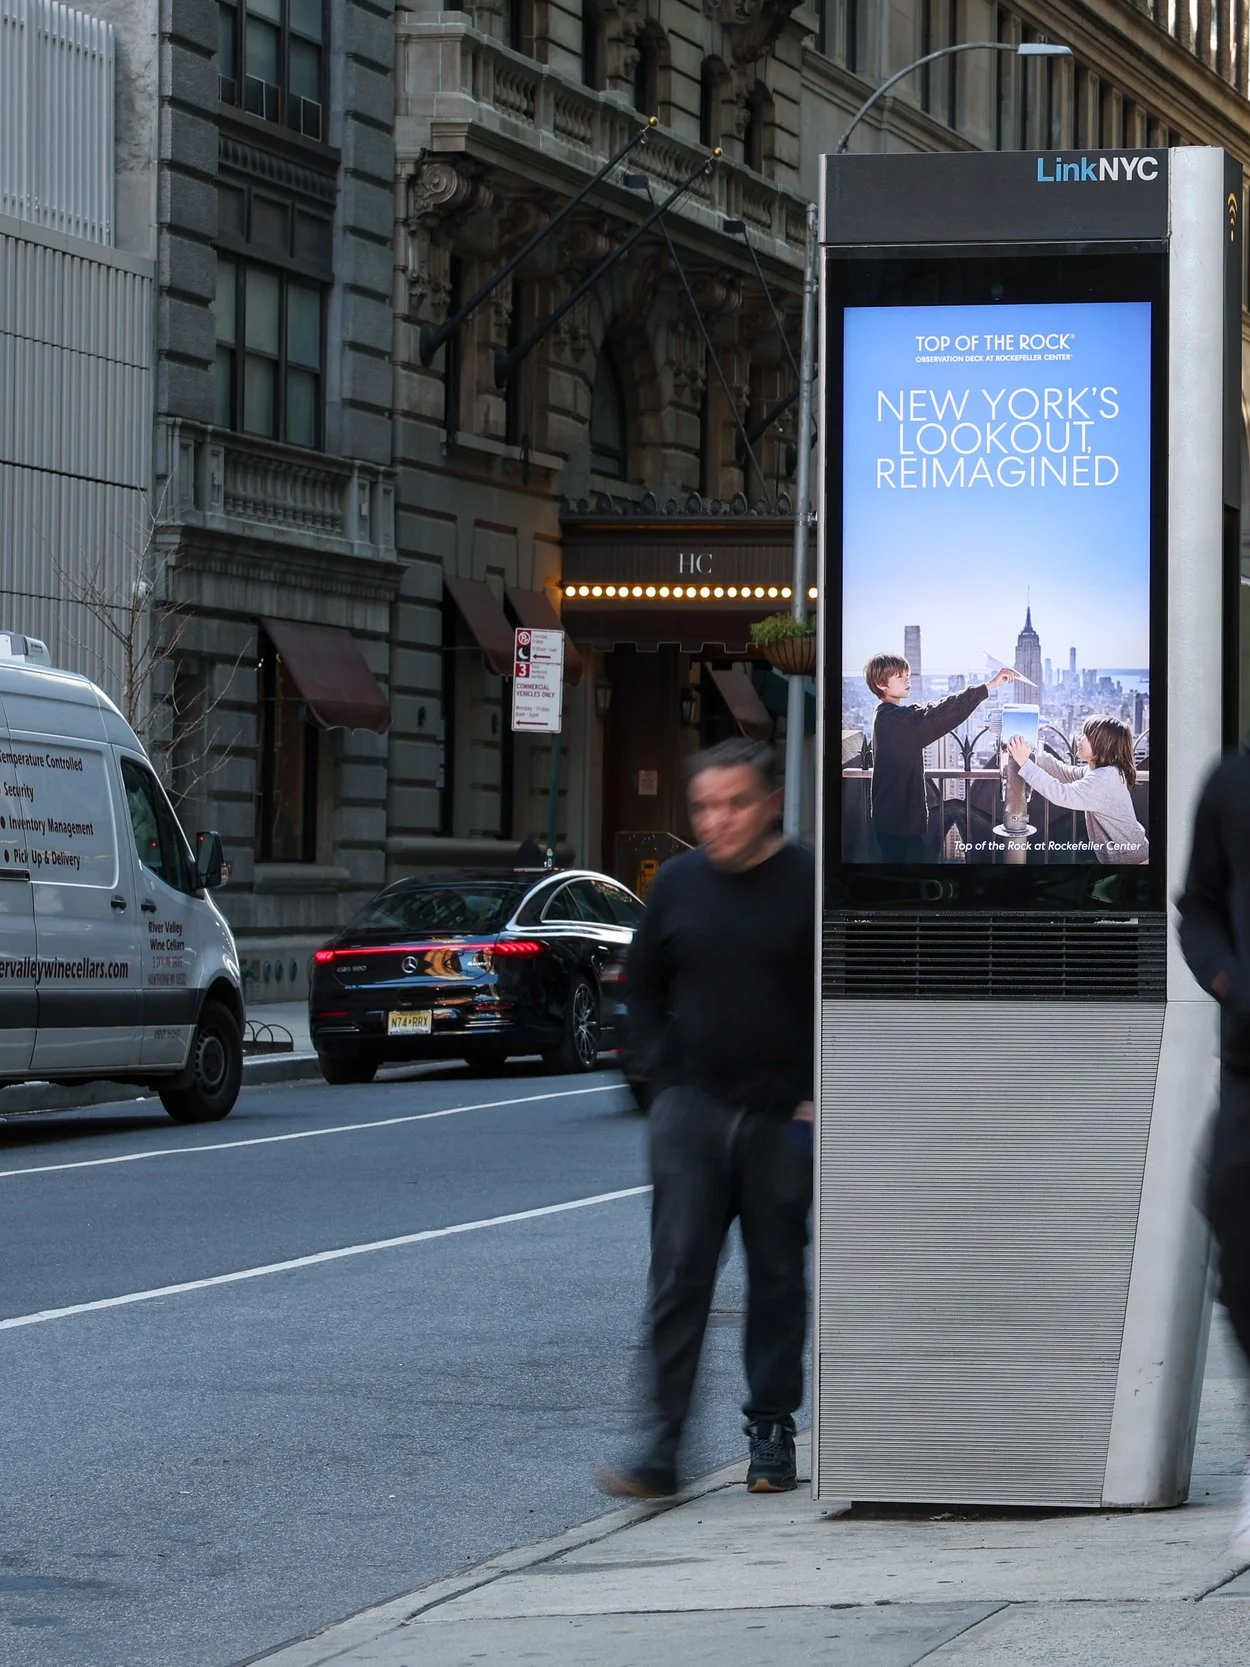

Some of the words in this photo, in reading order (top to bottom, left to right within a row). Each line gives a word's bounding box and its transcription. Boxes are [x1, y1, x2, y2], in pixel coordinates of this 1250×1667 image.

[1036, 156, 1159, 182] LinkNYC
[915, 335, 950, 352] TOP
[955, 335, 979, 351] OF
[984, 334, 1014, 351] THE
[915, 355, 964, 363] OBSERVATION
[985, 354, 994, 362] AT
[995, 354, 1042, 362] ROCKEFELLER
[876, 388, 971, 422] NEW
[898, 420, 1096, 455] LOOKOUT,
[876, 456, 1120, 489] REIMAGINED
[679, 553, 713, 575] HC
[518, 664, 526, 677] 3
[46, 755, 83, 771] Controlled
[4, 782, 34, 802] Security
[9, 815, 46, 836] Inventory
[47, 818, 94, 838] Management
[954, 840, 972, 852] Top
[974, 840, 986, 851] of
[988, 841, 1005, 851] the
[1007, 841, 1032, 851] Rock
[1034, 842, 1045, 851] at
[1048, 841, 1104, 851] Rockefeller
[1106, 841, 1141, 851] Center
[14, 849, 29, 864] Pick
[31, 850, 44, 868] Up
[44, 851, 49, 864] &
[51, 852, 81, 870] Delivery
[148, 921, 164, 933] River
[165, 921, 183, 937] Valley
[150, 938, 165, 951] Wine
[166, 938, 185, 951] Cellars
[0, 957, 129, 985] ervalleywinecellars.com
